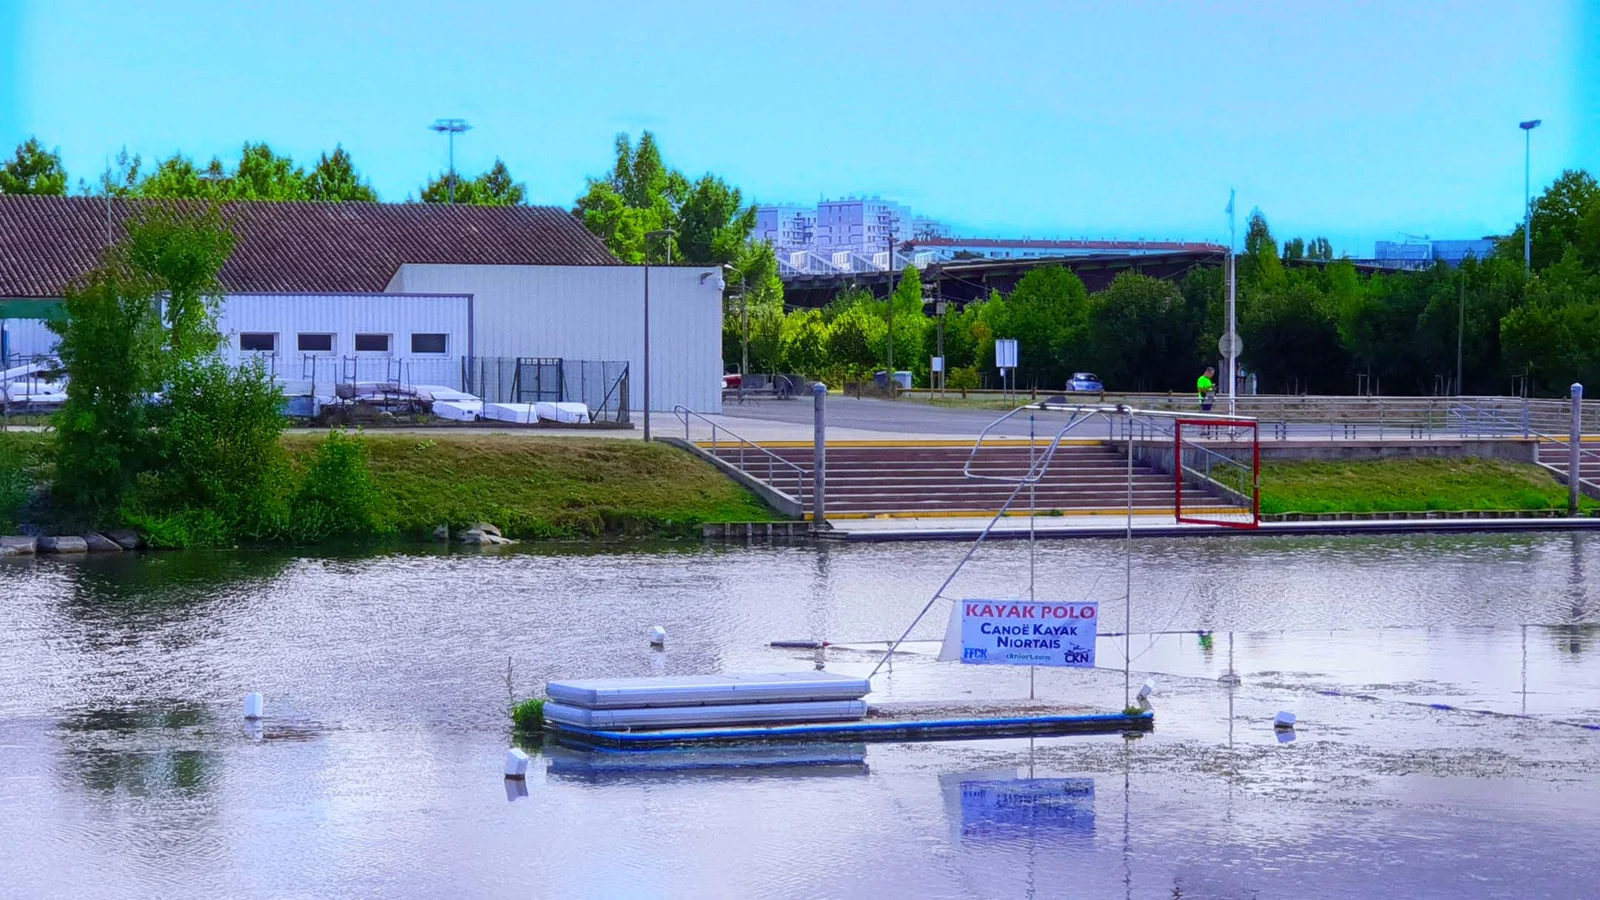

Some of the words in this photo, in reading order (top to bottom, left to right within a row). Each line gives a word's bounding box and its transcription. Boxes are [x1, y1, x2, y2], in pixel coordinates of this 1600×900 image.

[966, 603, 1036, 619] KAYAK
[1041, 605, 1095, 620] POLO
[1033, 624, 1078, 636] KAYAK
[997, 636, 1061, 649] NIORTAIS
[964, 647, 988, 659] FFCK
